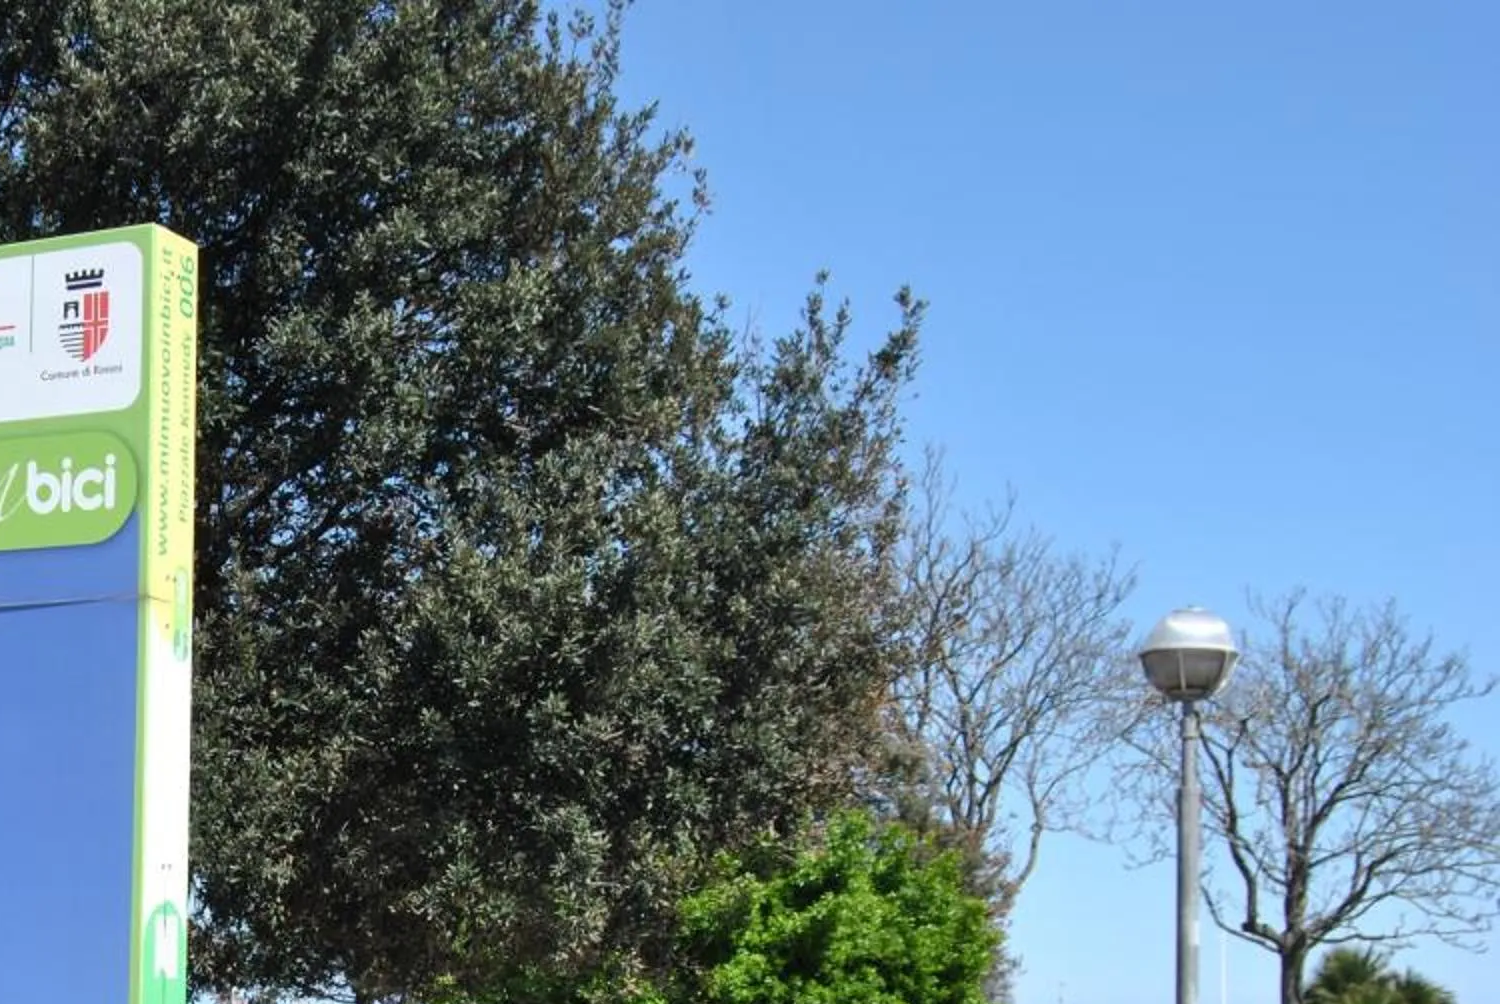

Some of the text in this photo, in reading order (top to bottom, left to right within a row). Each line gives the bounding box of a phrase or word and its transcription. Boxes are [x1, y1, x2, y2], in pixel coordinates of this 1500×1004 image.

[40, 369, 79, 381] Comune
[82, 365, 91, 377] di
[158, 247, 173, 556] www.mimuovoinbici.it
[27, 453, 116, 514] bici
